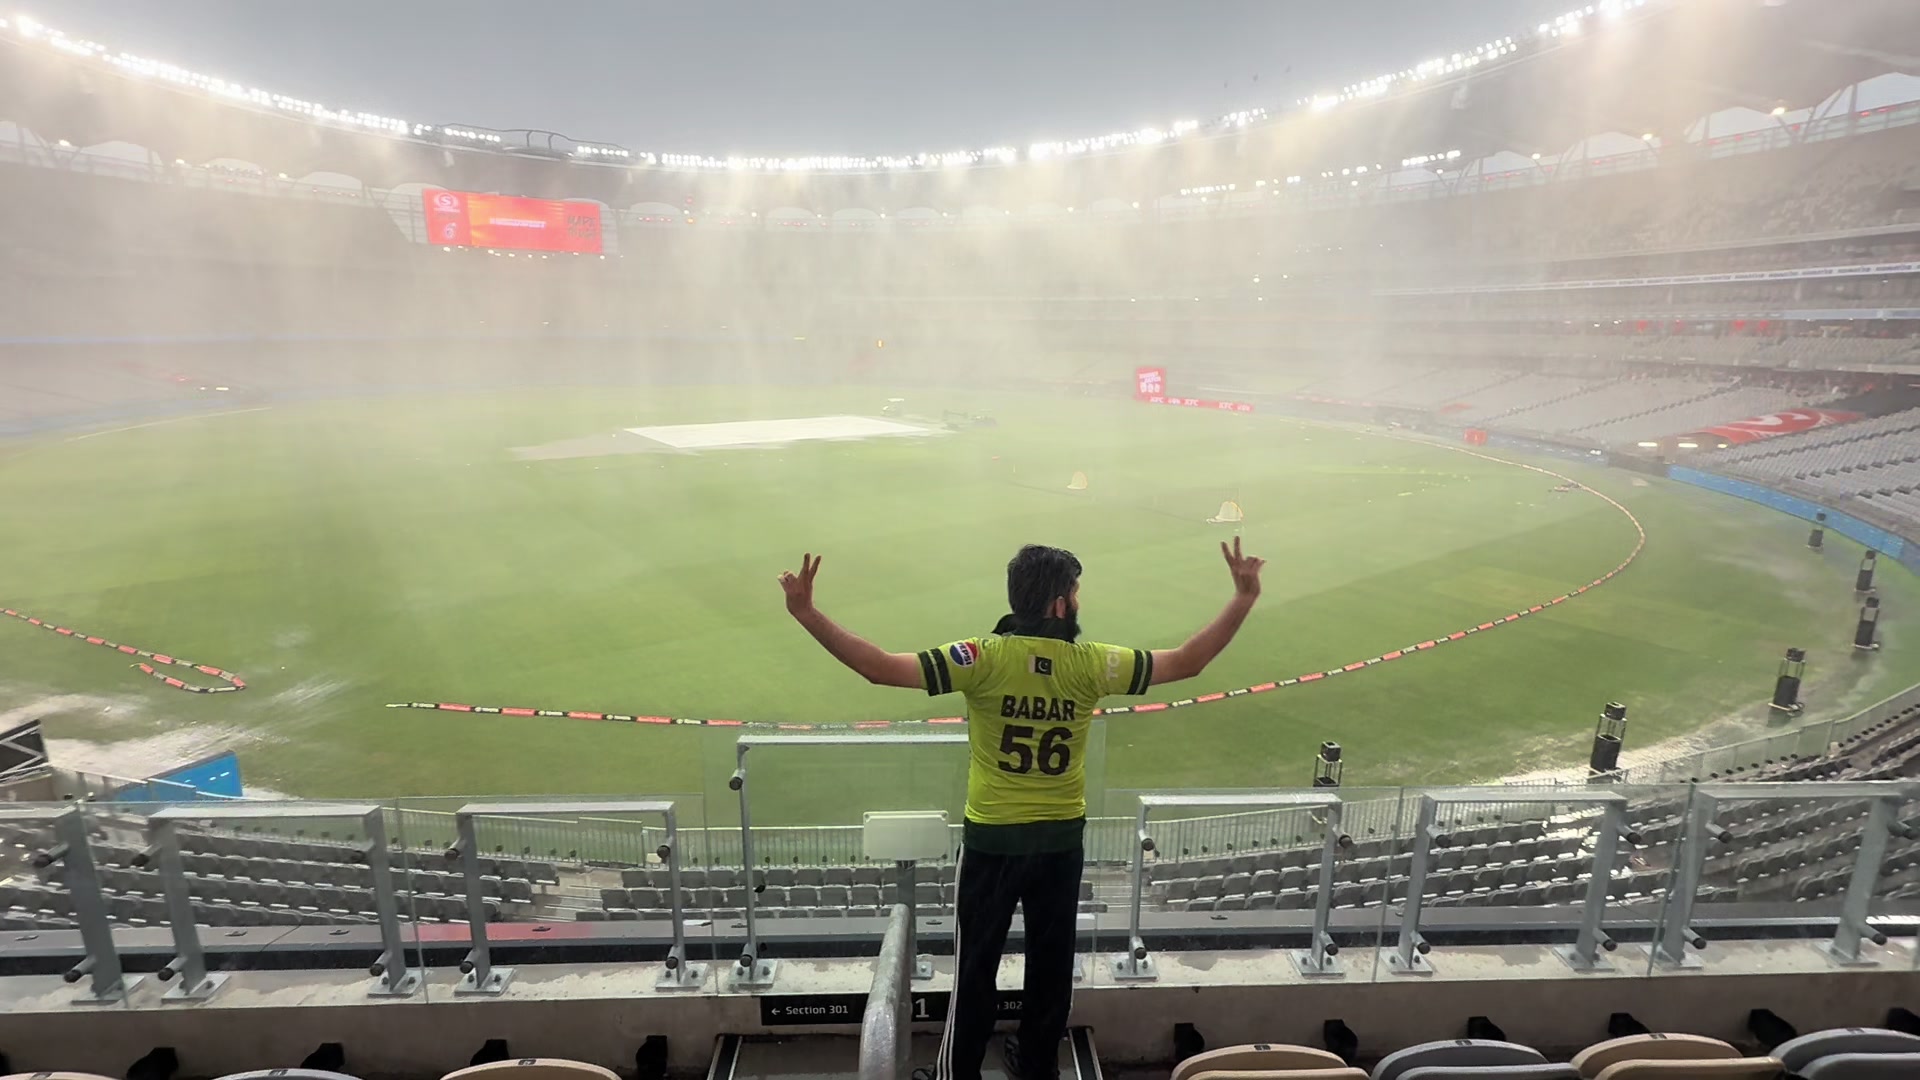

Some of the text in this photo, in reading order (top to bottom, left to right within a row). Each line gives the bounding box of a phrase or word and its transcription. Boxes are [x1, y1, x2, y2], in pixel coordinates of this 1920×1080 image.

[1218, 402, 1233, 411] KFC
[1000, 694, 1076, 722] BABAR
[997, 723, 1074, 776] 56
[785, 1004, 849, 1015] Section 301
[1003, 1000, 1024, 1010] 302
